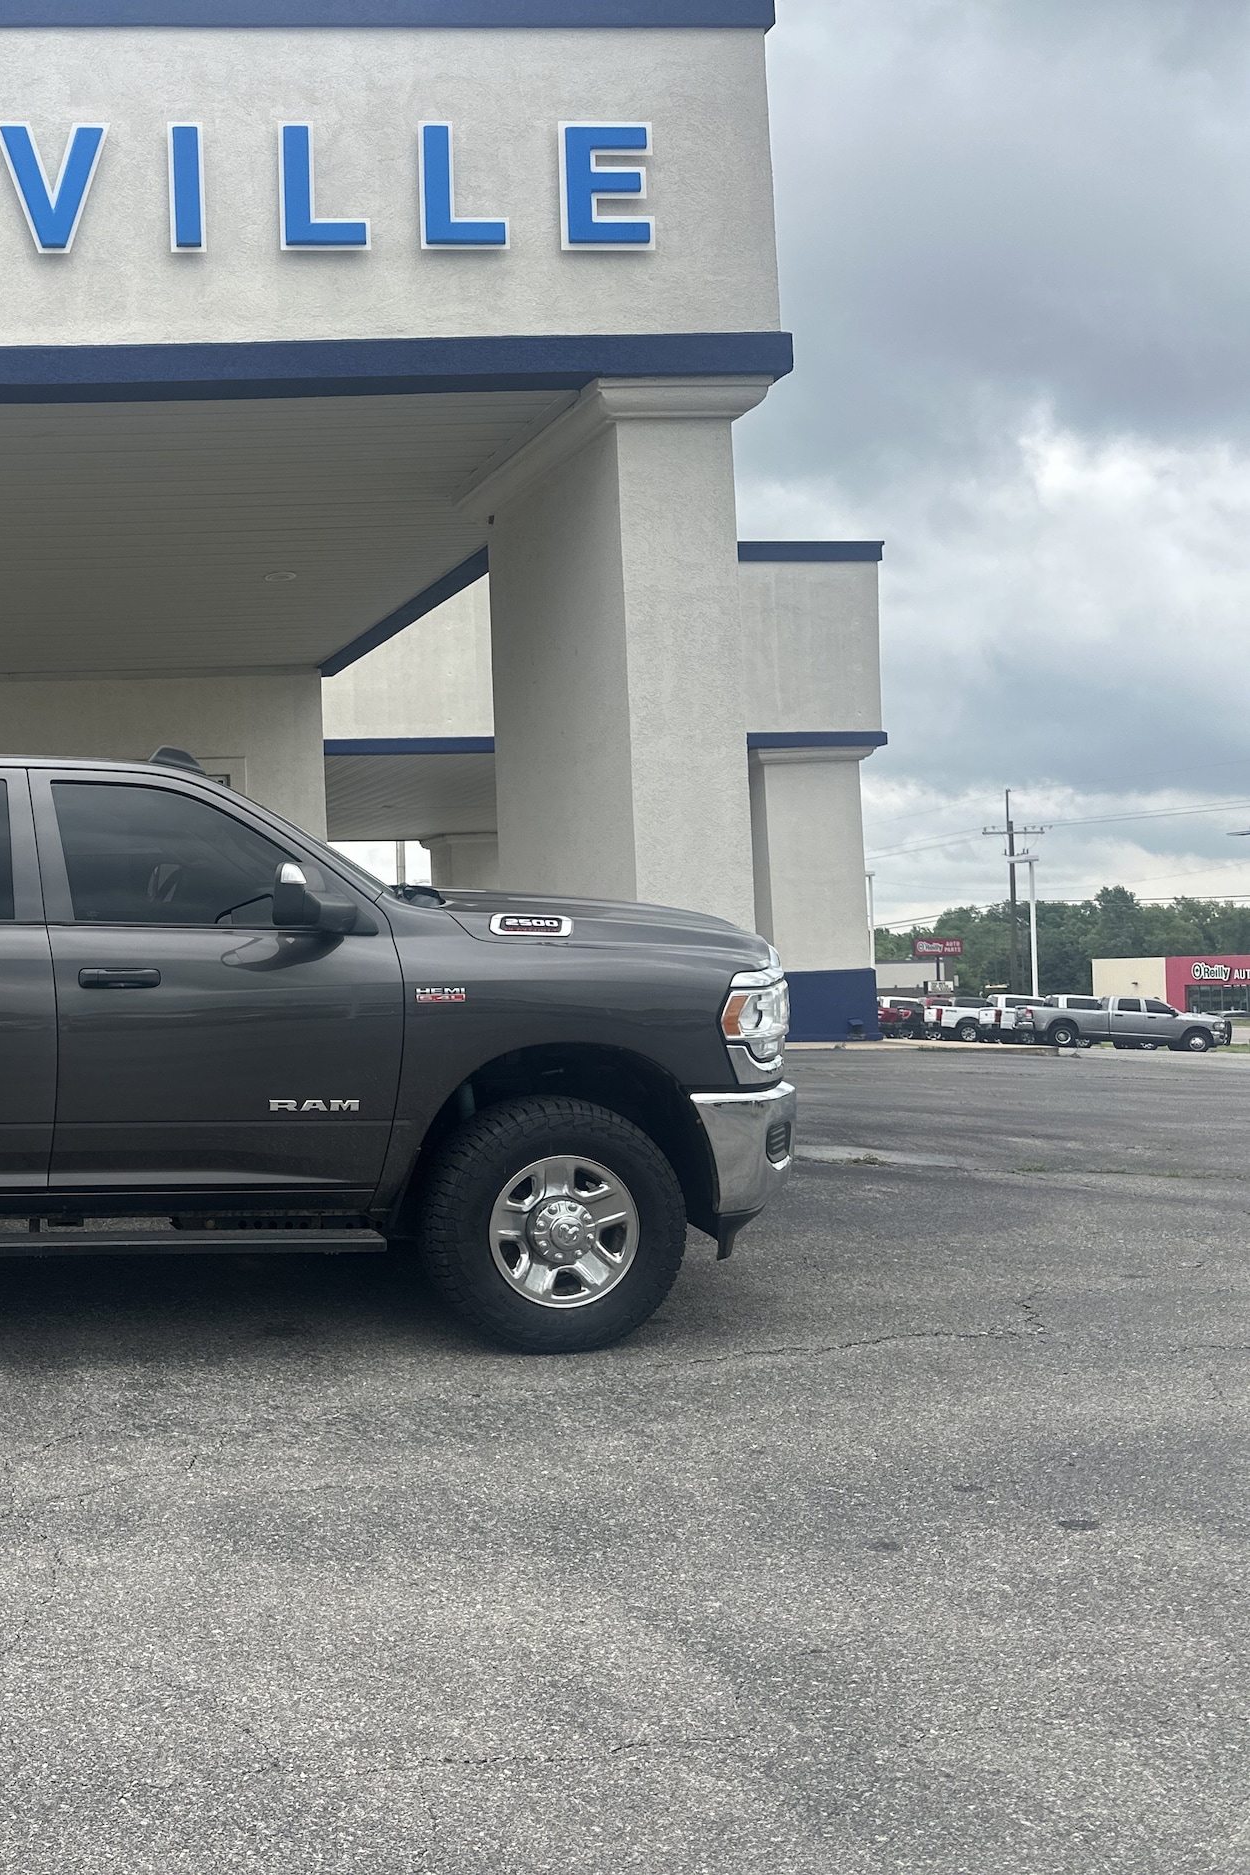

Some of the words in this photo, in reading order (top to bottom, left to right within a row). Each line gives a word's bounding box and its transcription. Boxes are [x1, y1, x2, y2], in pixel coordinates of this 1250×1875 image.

[505, 918, 559, 927] 2500
[1191, 962, 1230, 981] O'Reilly
[269, 1099, 360, 1111] RAM
